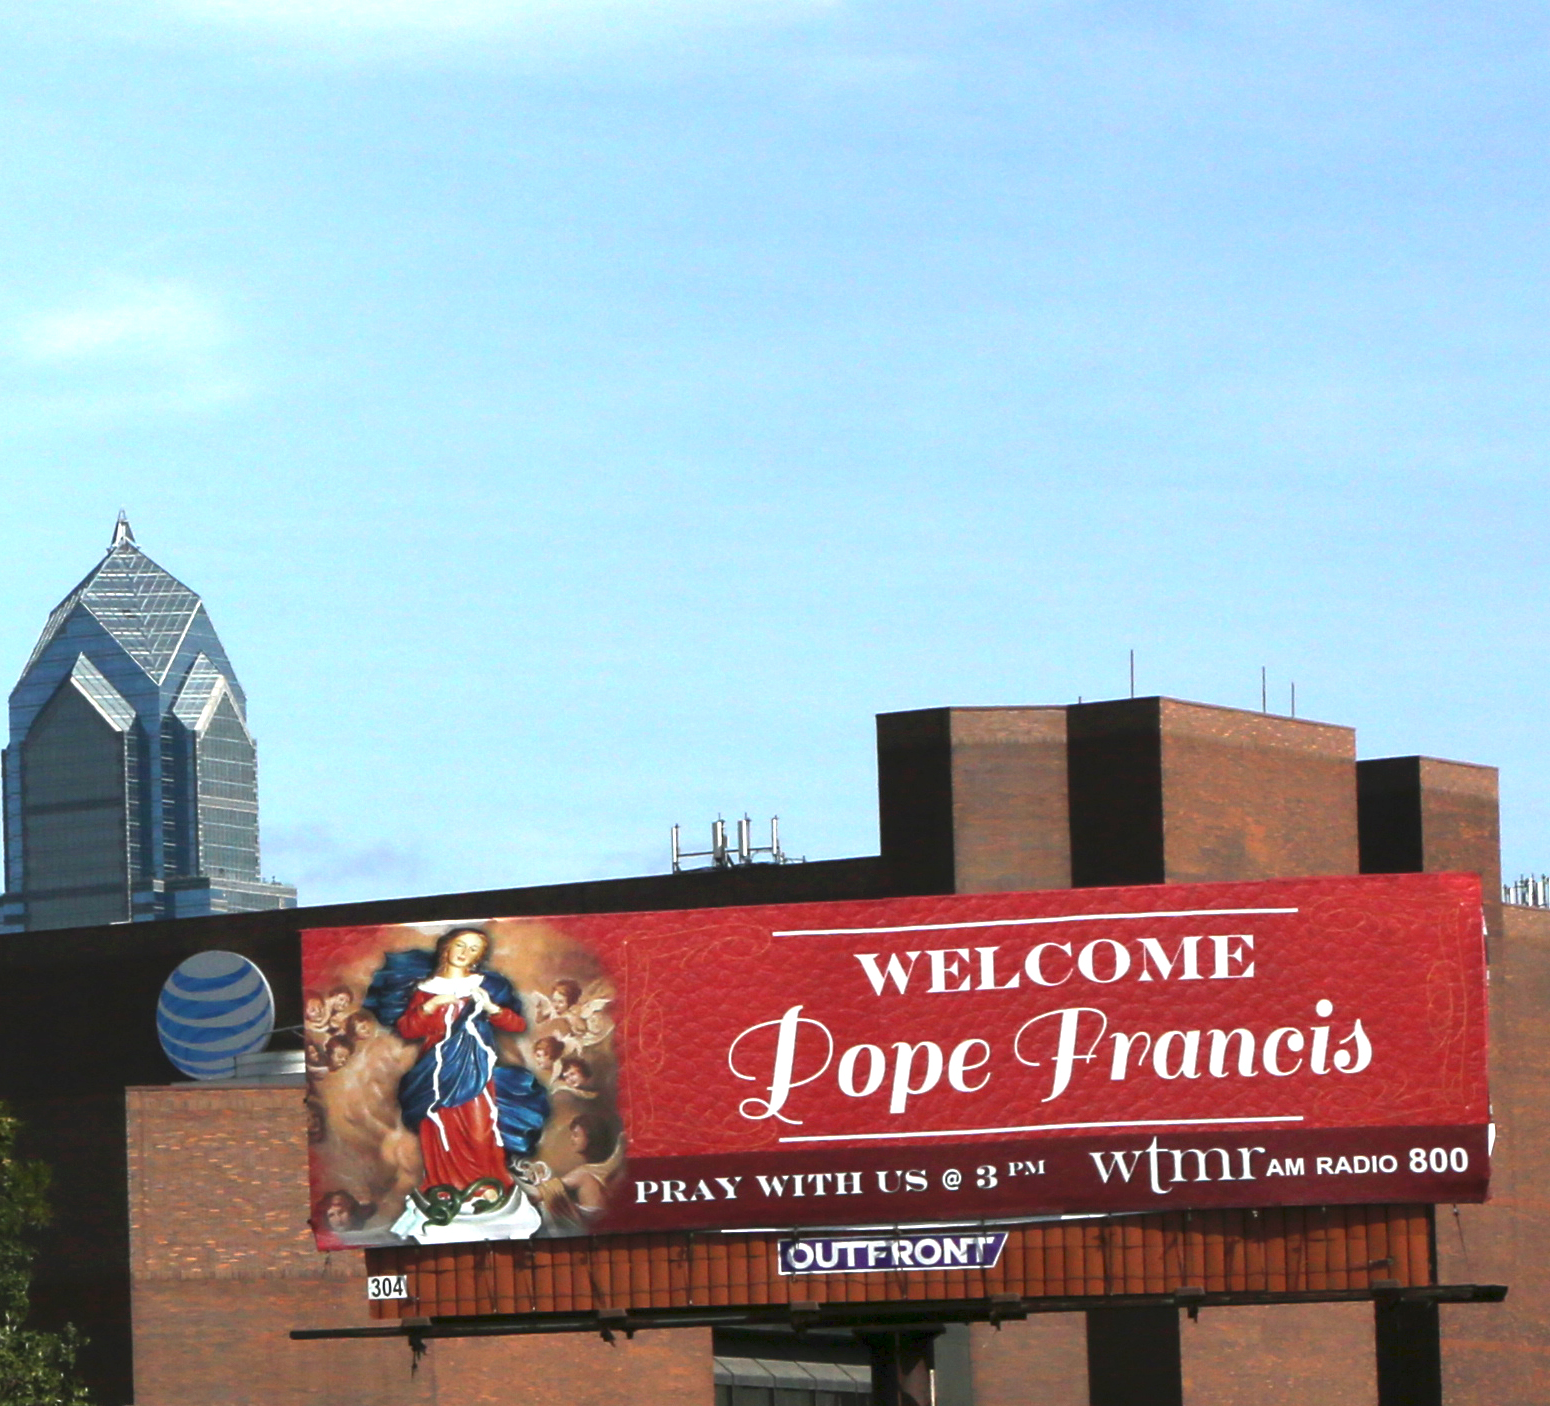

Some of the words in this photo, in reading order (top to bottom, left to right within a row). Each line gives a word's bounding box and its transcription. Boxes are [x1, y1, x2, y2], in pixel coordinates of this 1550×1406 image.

[854, 934, 1255, 996] WELCOME
[728, 1004, 991, 1125] Pope
[1014, 999, 1373, 1102] Francis
[635, 1176, 742, 1203] PRAY
[755, 1171, 863, 1198] WITH
[876, 1169, 928, 1193] US
[941, 1167, 962, 1191] @
[976, 1165, 998, 1189] 3
[1008, 1160, 1046, 1177] PM
[1089, 1135, 1265, 1194] wtmr
[1267, 1157, 1304, 1177] AM
[1317, 1155, 1398, 1175] RADIO
[1409, 1147, 1469, 1173] 800
[787, 1237, 995, 1269] OUTFRONT
[371, 1276, 403, 1298] 304
